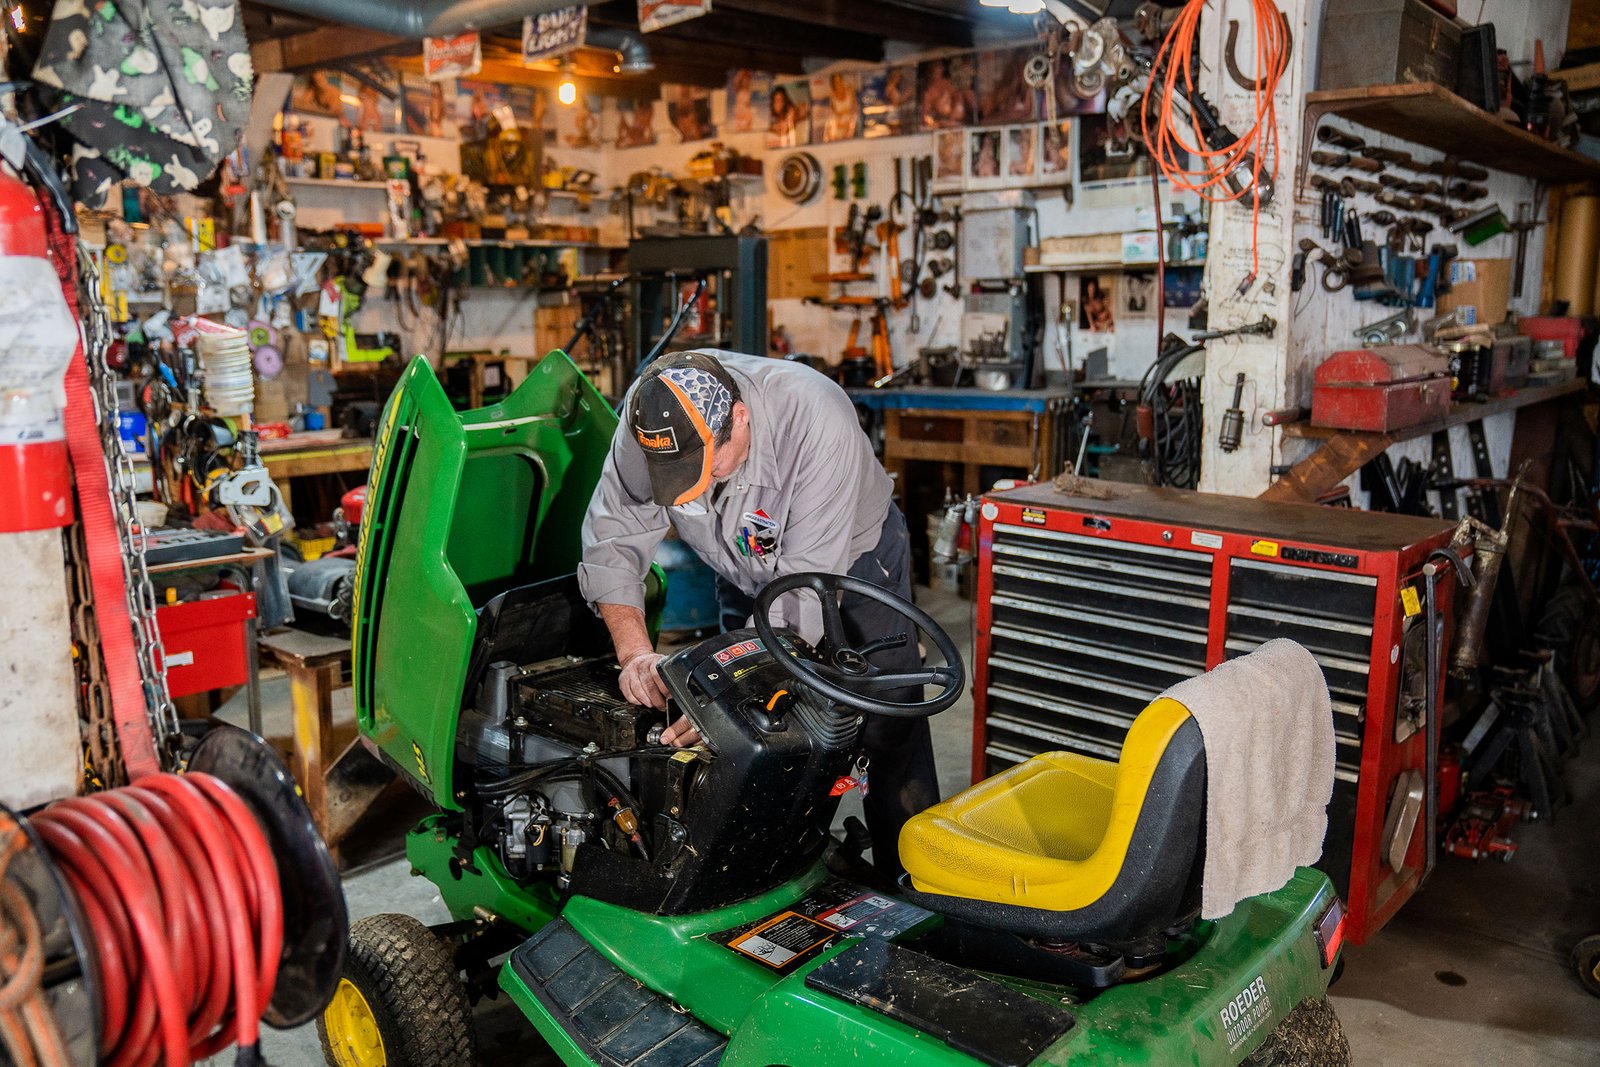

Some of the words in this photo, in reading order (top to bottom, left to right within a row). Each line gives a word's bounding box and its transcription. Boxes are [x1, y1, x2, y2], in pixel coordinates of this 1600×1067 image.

[1220, 975, 1267, 1030] ROEDER
[1226, 1013, 1253, 1046] OUTDOOR
[1252, 996, 1272, 1021] POWER
